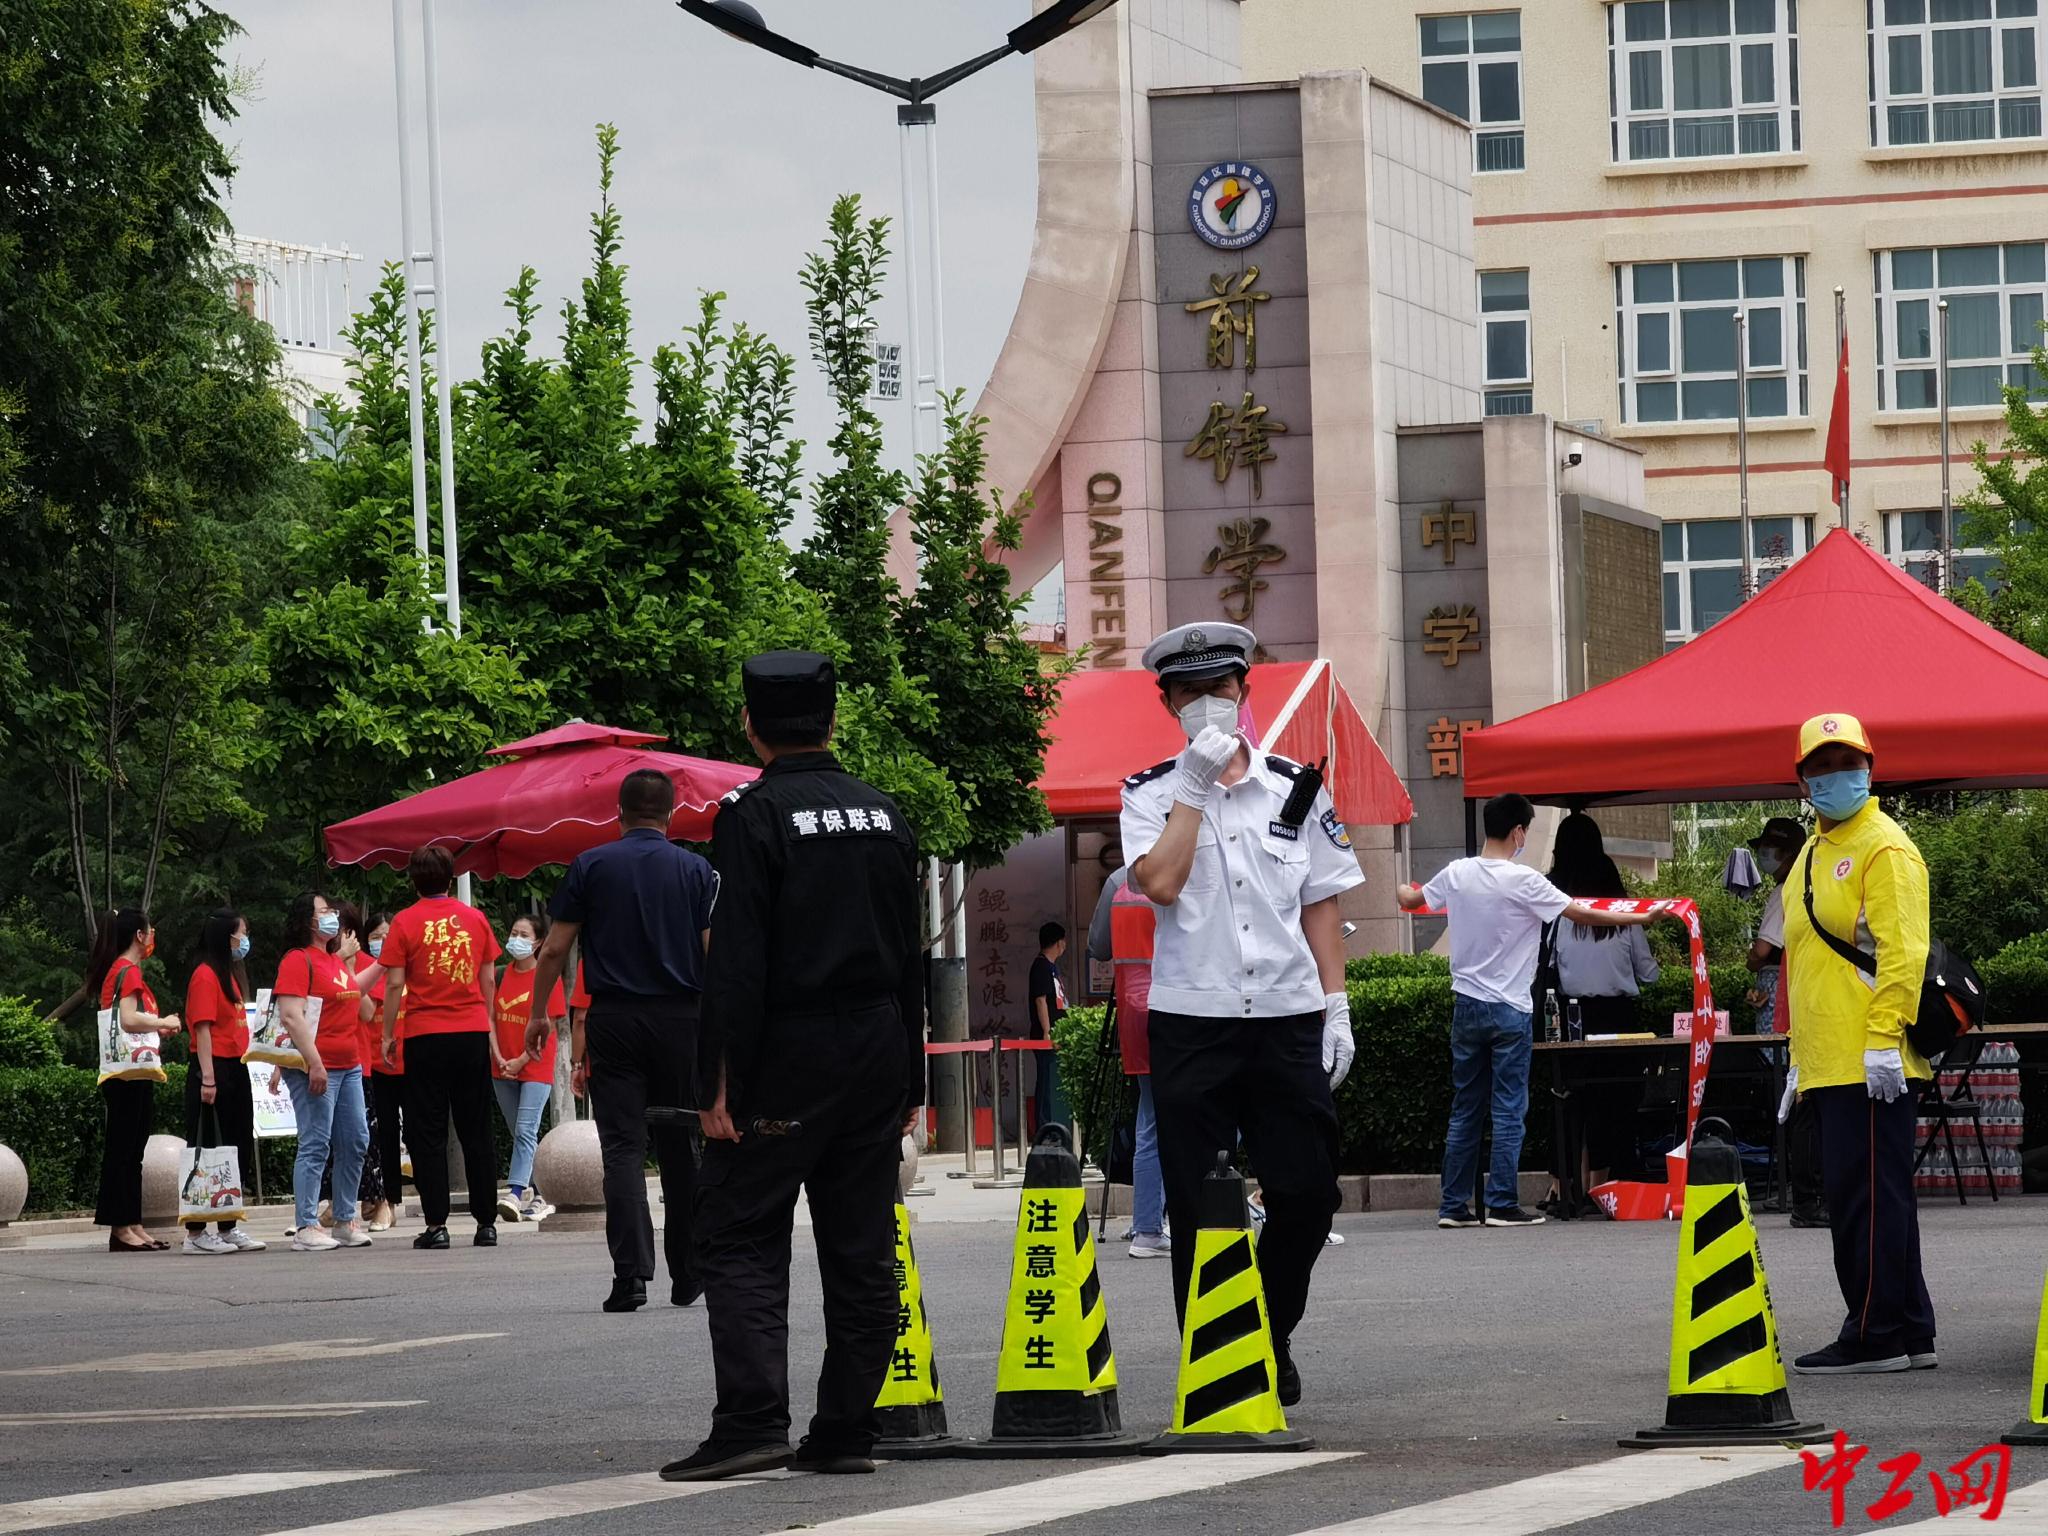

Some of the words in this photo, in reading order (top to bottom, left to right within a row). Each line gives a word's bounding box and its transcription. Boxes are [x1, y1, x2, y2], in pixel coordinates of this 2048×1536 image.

[1256, 202, 1272, 232] SCHOOL
[1184, 265, 1288, 662] 前锋学
[1421, 499, 1484, 778] 中学部
[792, 808, 892, 836] 警保联动
[1024, 1198, 1058, 1369] 注意学生
